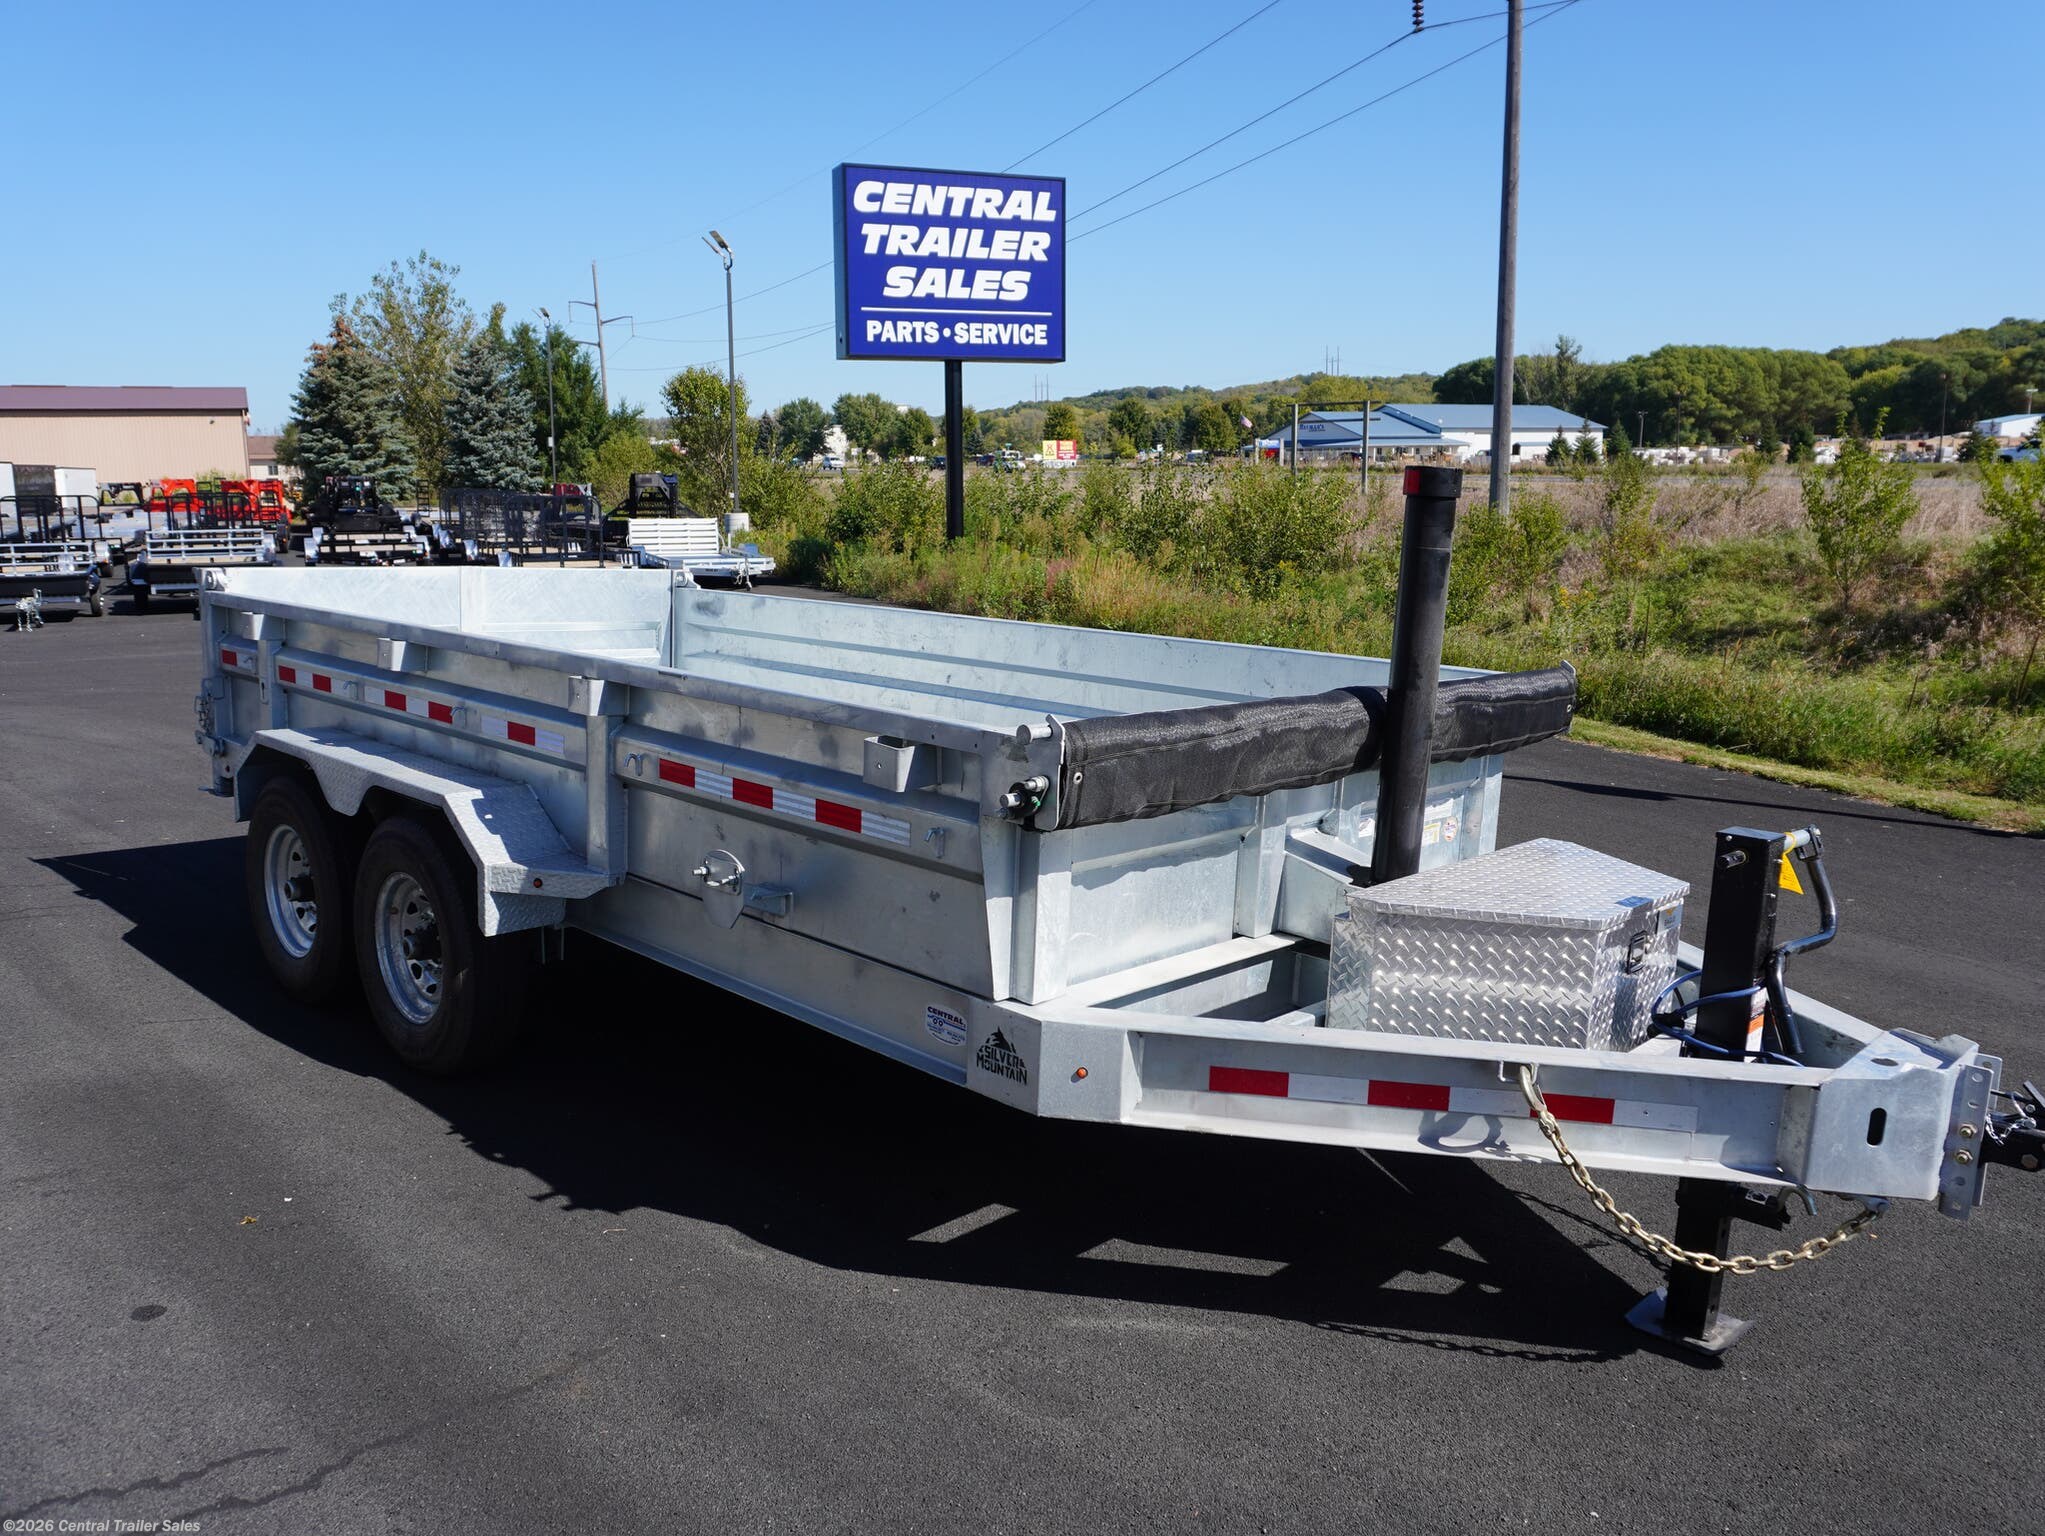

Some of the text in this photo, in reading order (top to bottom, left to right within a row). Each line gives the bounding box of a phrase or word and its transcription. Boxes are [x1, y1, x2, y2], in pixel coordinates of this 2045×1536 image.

[853, 180, 1057, 222] CENTRAL
[861, 223, 1051, 261] TRAILER
[882, 266, 1032, 301] SALES
[866, 320, 1048, 345] PARTS SERVICE
[927, 1006, 963, 1025] CENTRAL
[976, 1052, 1028, 1085] MOUNTAIN
[984, 1045, 1020, 1069] SILVER
